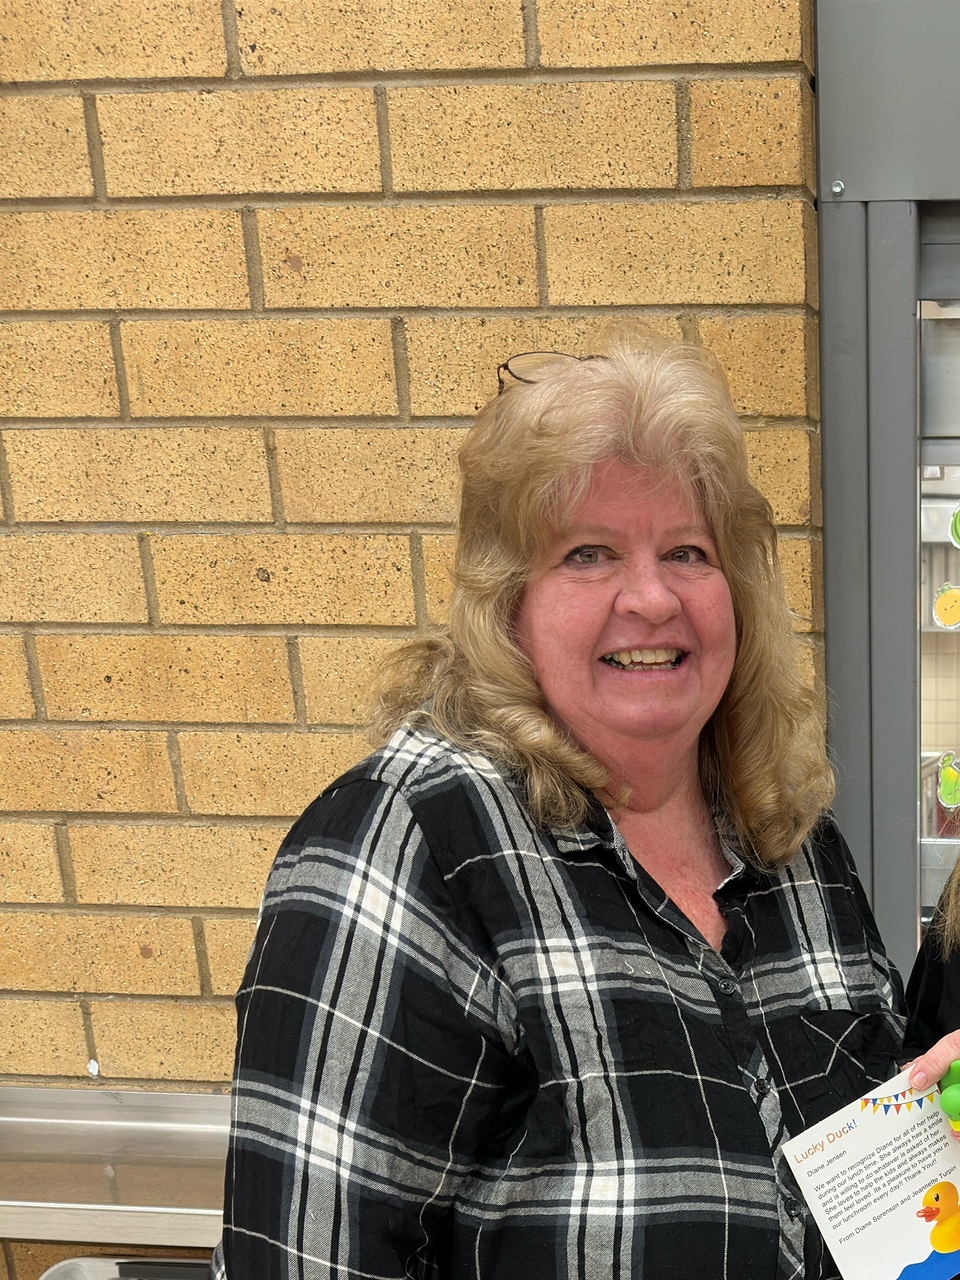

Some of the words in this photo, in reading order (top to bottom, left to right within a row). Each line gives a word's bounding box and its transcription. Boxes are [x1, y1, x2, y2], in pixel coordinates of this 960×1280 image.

[793, 1140, 824, 1164] Lucky
[825, 1118, 857, 1144] Duck!
[806, 1163, 825, 1177] Diane
[825, 1149, 847, 1166] Jensen
[813, 1183, 825, 1192] We
[824, 1172, 840, 1185] want
[847, 1151, 875, 1172] recognize
[875, 1140, 893, 1154] Diane
[893, 1134, 901, 1142] for
[902, 1128, 910, 1137] all
[909, 1123, 916, 1132] of
[915, 1118, 926, 1128] her
[926, 1110, 939, 1121] help
[817, 1185, 837, 1200] during
[836, 1178, 846, 1188] our
[846, 1168, 864, 1181] lunch
[863, 1159, 879, 1171] time.
[878, 1150, 891, 1161] She
[891, 1137, 911, 1153] always
[910, 1130, 922, 1140] has
[927, 1117, 943, 1130] smile
[821, 1196, 833, 1207] and
[839, 1181, 858, 1195] willing
[864, 1172, 873, 1180] do
[873, 1154, 899, 1174] whatever
[905, 1139, 923, 1154] asked
[923, 1134, 929, 1142] of
[929, 1129, 941, 1138] her.
[824, 1204, 837, 1214] She
[836, 1194, 853, 1207] loves
[859, 1181, 873, 1192] help
[873, 1174, 883, 1183] the
[883, 1167, 896, 1177] kids
[896, 1158, 908, 1169] and
[908, 1146, 927, 1162] always
[927, 1134, 946, 1149] makes
[827, 1209, 843, 1222] them
[843, 1201, 855, 1212] feel
[854, 1190, 873, 1205] loved.
[886, 1166, 911, 1186] pleasure
[917, 1153, 932, 1164] have
[931, 1145, 943, 1156] you
[831, 1220, 842, 1229] our
[841, 1201, 872, 1223] lunchroom
[872, 1190, 888, 1203] every
[903, 1169, 922, 1182] Thank
[838, 1231, 855, 1244] From
[854, 1220, 872, 1234] Diane
[899, 1193, 911, 1205] and
[911, 1177, 938, 1197] Jeannette
[938, 1165, 957, 1178] Turpin
